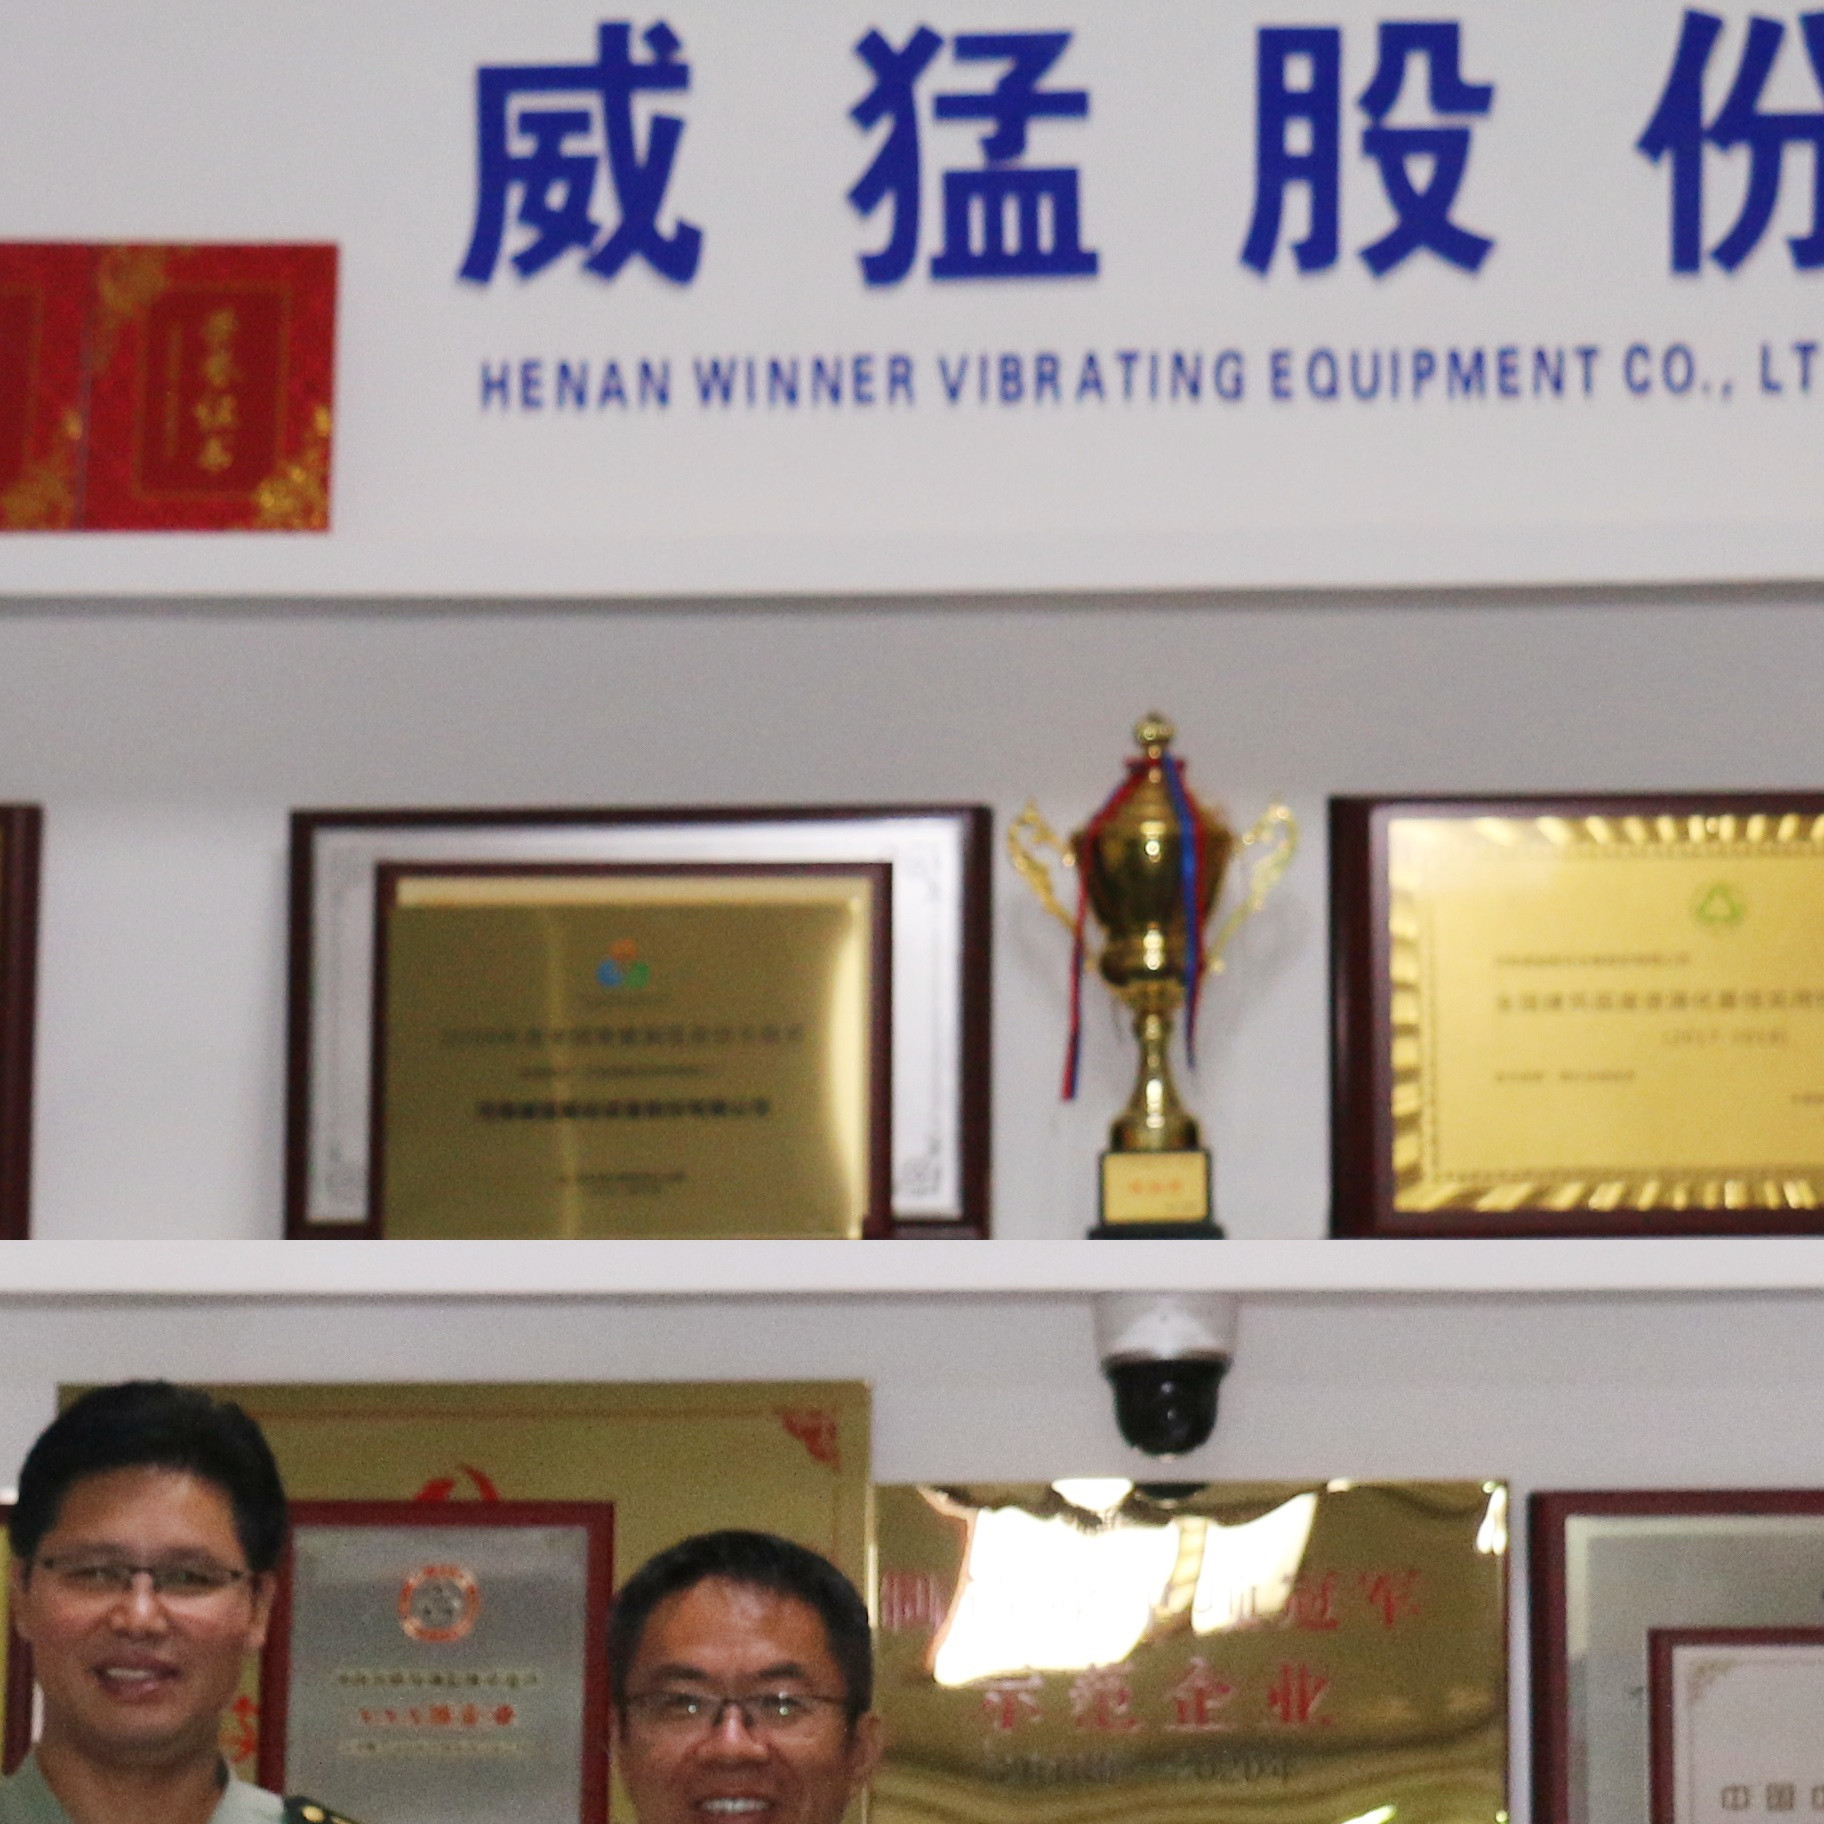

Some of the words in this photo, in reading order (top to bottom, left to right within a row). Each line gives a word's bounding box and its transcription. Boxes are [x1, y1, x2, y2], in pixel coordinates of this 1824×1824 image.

[479, 358, 672, 411] HENAN
[693, 354, 917, 408] WINNER
[937, 348, 1246, 403] VIBRATING
[1268, 344, 1600, 400] EQUIPMENT
